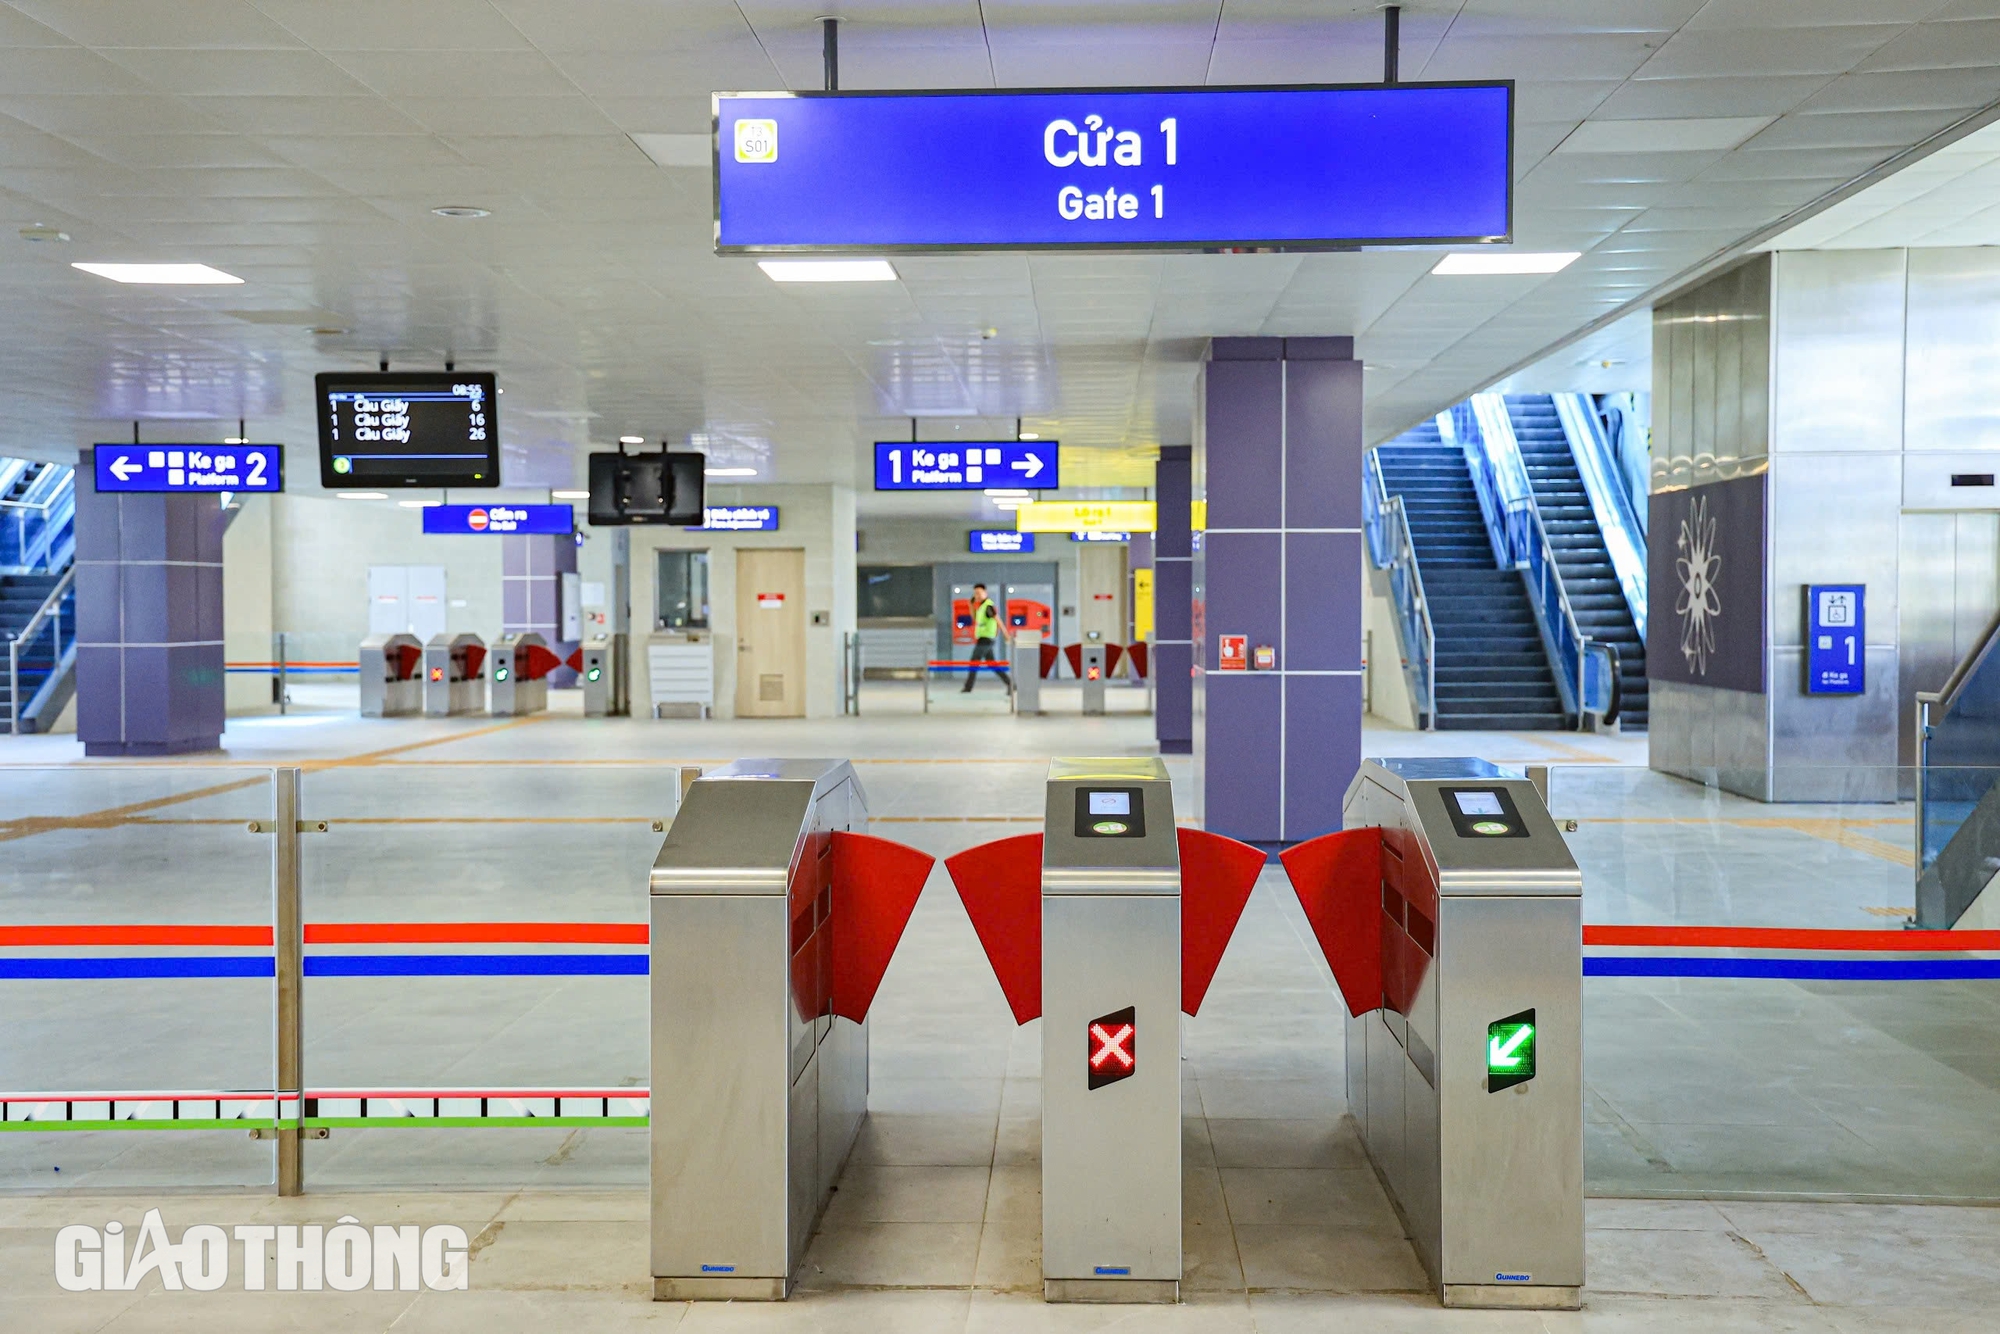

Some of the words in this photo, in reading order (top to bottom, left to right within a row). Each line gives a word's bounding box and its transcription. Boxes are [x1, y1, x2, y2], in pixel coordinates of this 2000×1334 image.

[745, 139, 768, 153] S01
[1044, 114, 1142, 167] Cửa
[1160, 118, 1177, 166] 1
[1058, 185, 1139, 220] Gate
[1151, 184, 1163, 219] 1
[330, 400, 338, 413] 1
[471, 400, 481, 413] 6
[331, 413, 339, 426] 1
[468, 413, 486, 427] 16
[331, 427, 339, 441] 1
[468, 427, 486, 441] 26
[188, 451, 212, 469] Ke
[214, 456, 236, 473] ga
[245, 451, 268, 486] 2
[888, 449, 902, 484] 1
[912, 449, 935, 467] Ke
[938, 453, 959, 470] ga
[188, 472, 239, 485] Platform
[912, 470, 962, 483] Platform
[1844, 635, 1856, 666] 1
